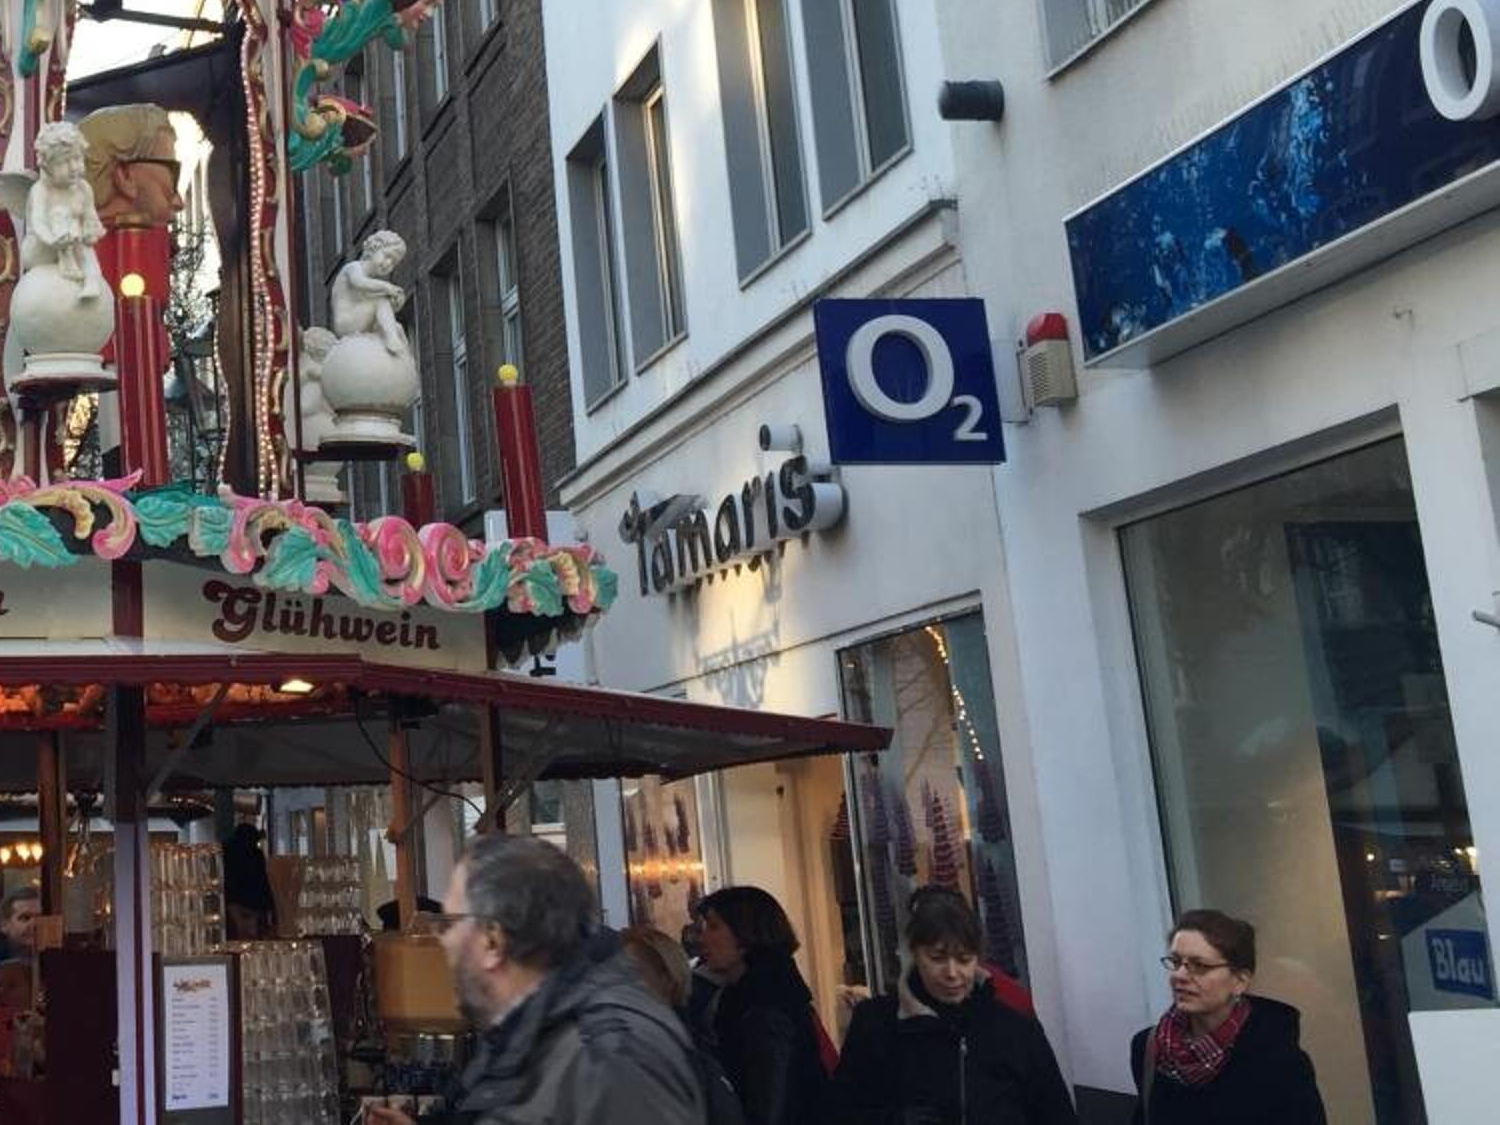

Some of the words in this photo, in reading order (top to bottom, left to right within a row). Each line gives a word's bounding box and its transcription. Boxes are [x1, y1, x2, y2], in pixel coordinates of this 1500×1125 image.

[619, 424, 825, 597] Tamaris
[202, 579, 440, 650] Glühwein
[1431, 937, 1485, 984] Blau
